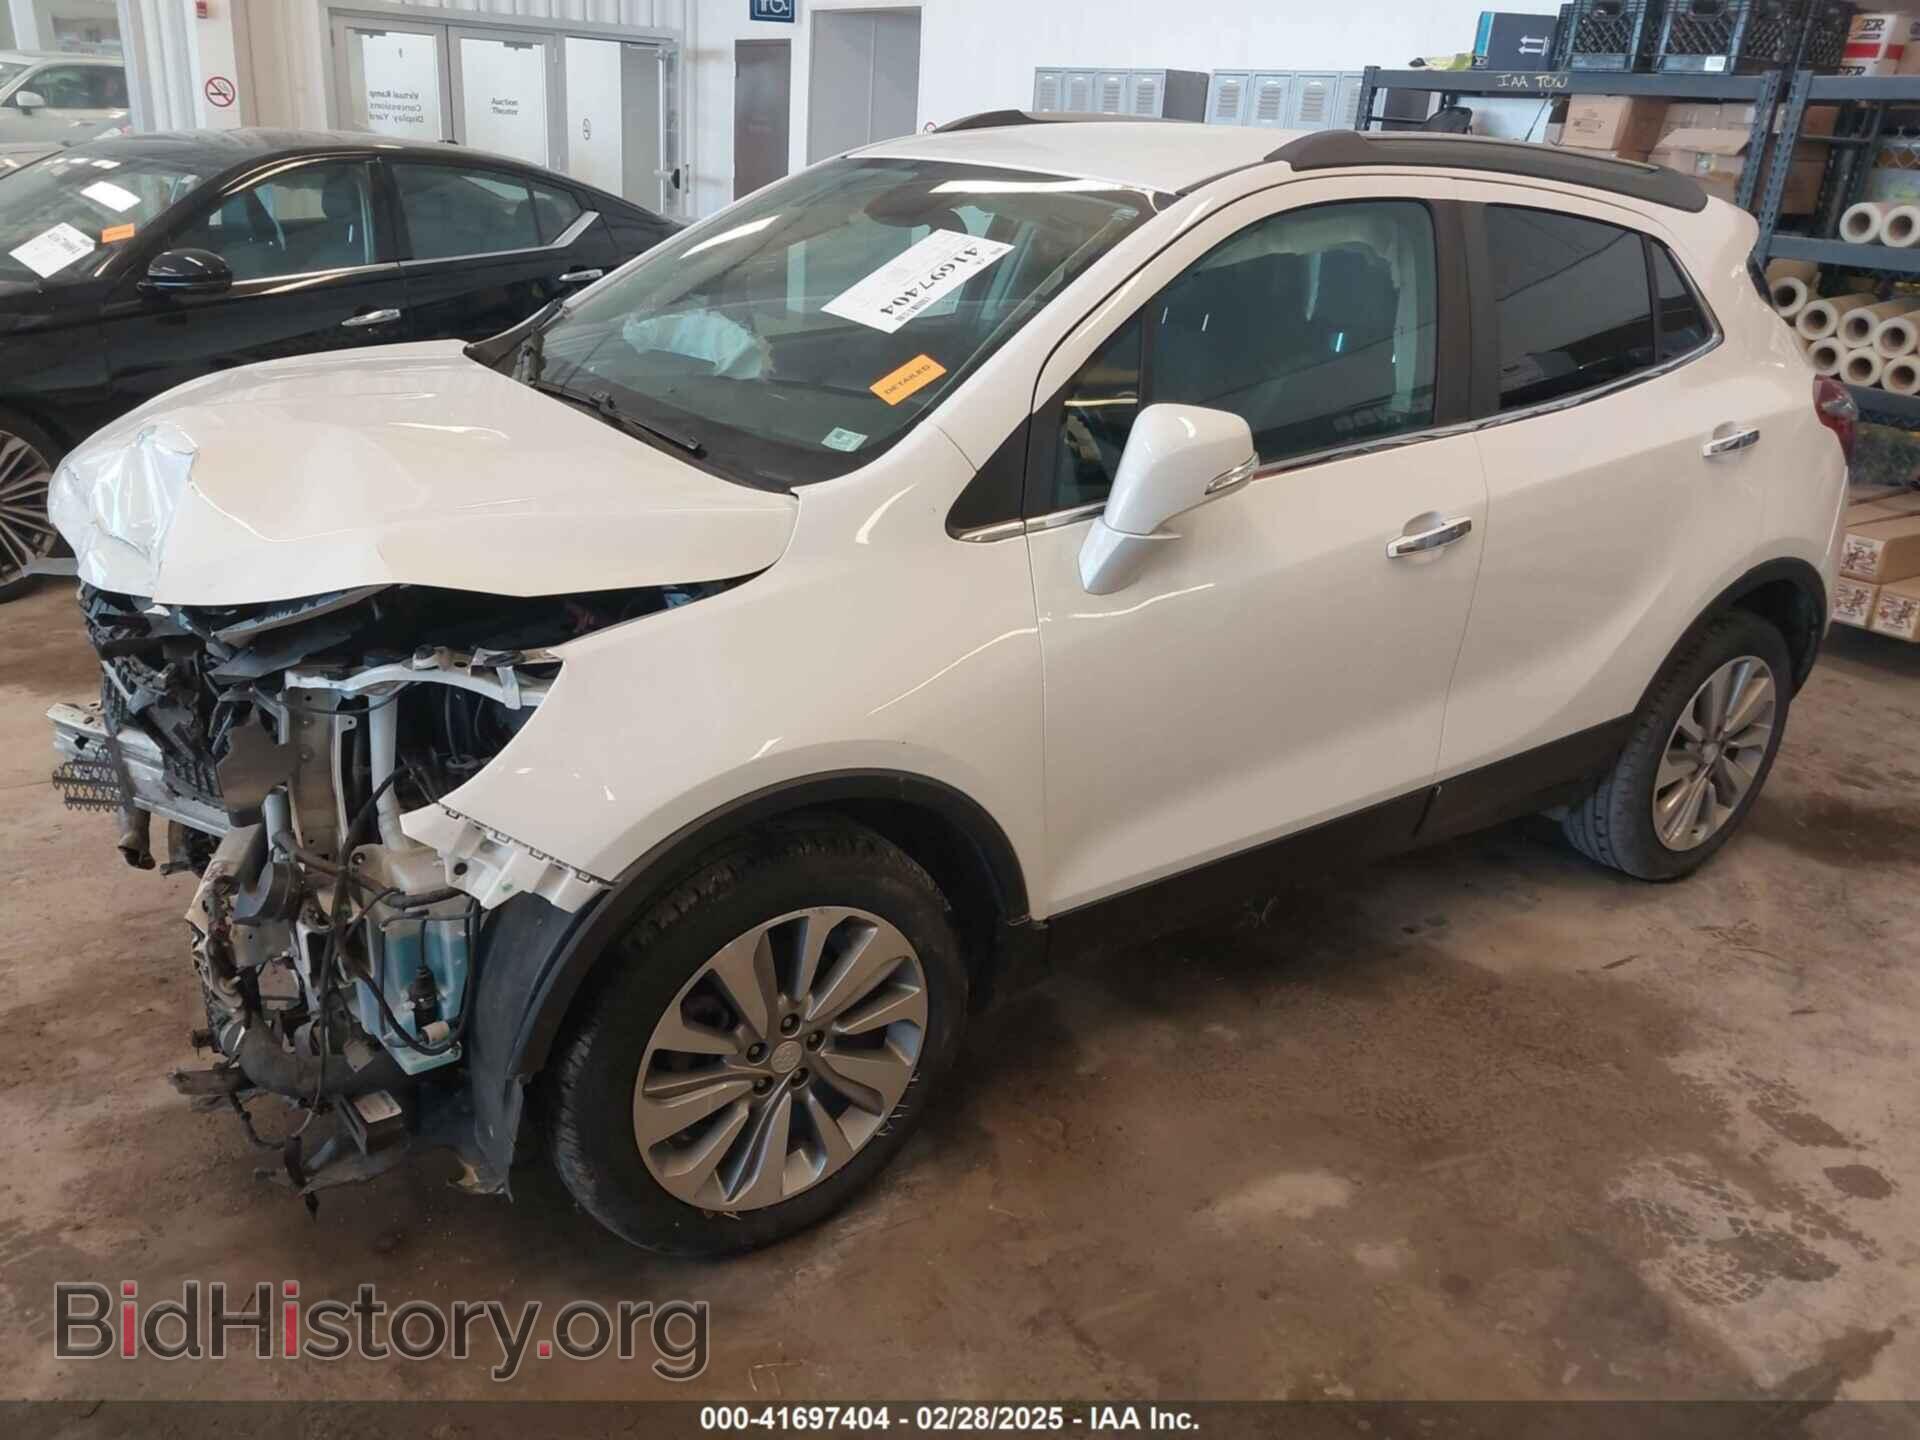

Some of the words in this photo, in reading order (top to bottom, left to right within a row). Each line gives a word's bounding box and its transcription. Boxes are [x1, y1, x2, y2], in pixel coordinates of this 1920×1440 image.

[1496, 73, 1529, 88] IAA
[1534, 74, 1569, 88] TOW
[491, 97, 518, 106] Auction
[880, 247, 978, 315] 41697404
[884, 364, 931, 395] DETAILED
